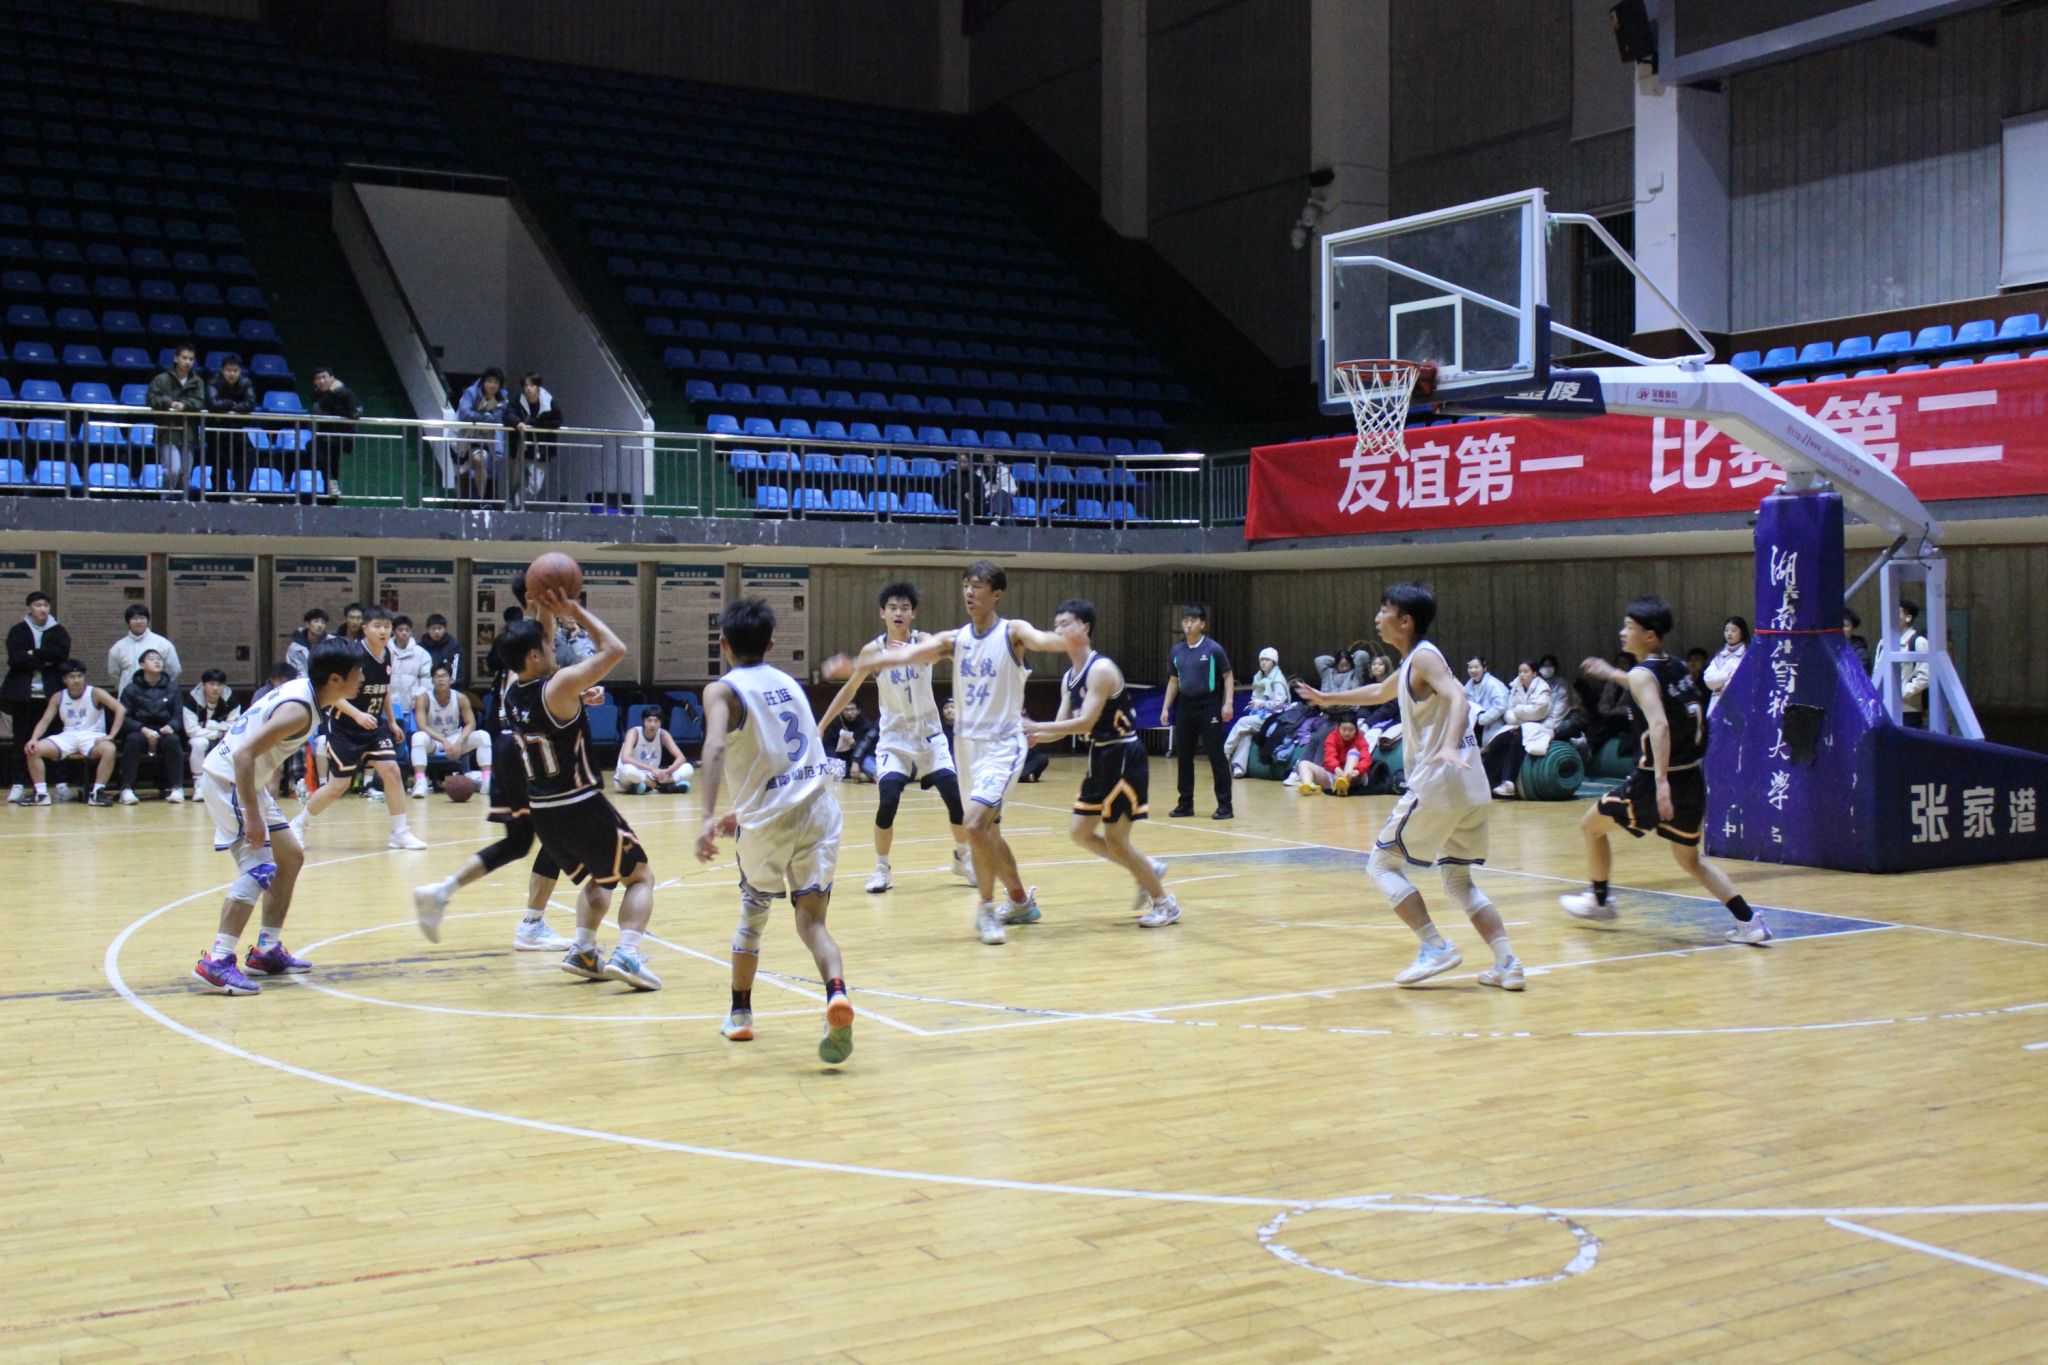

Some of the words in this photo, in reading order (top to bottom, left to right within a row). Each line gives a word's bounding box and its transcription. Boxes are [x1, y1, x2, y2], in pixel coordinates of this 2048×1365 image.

[1337, 431, 1584, 515] 友谊第一
[965, 683, 990, 706] 34
[778, 711, 809, 762] 3
[881, 753, 890, 767] 7
[1910, 781, 2037, 843] 张家港
